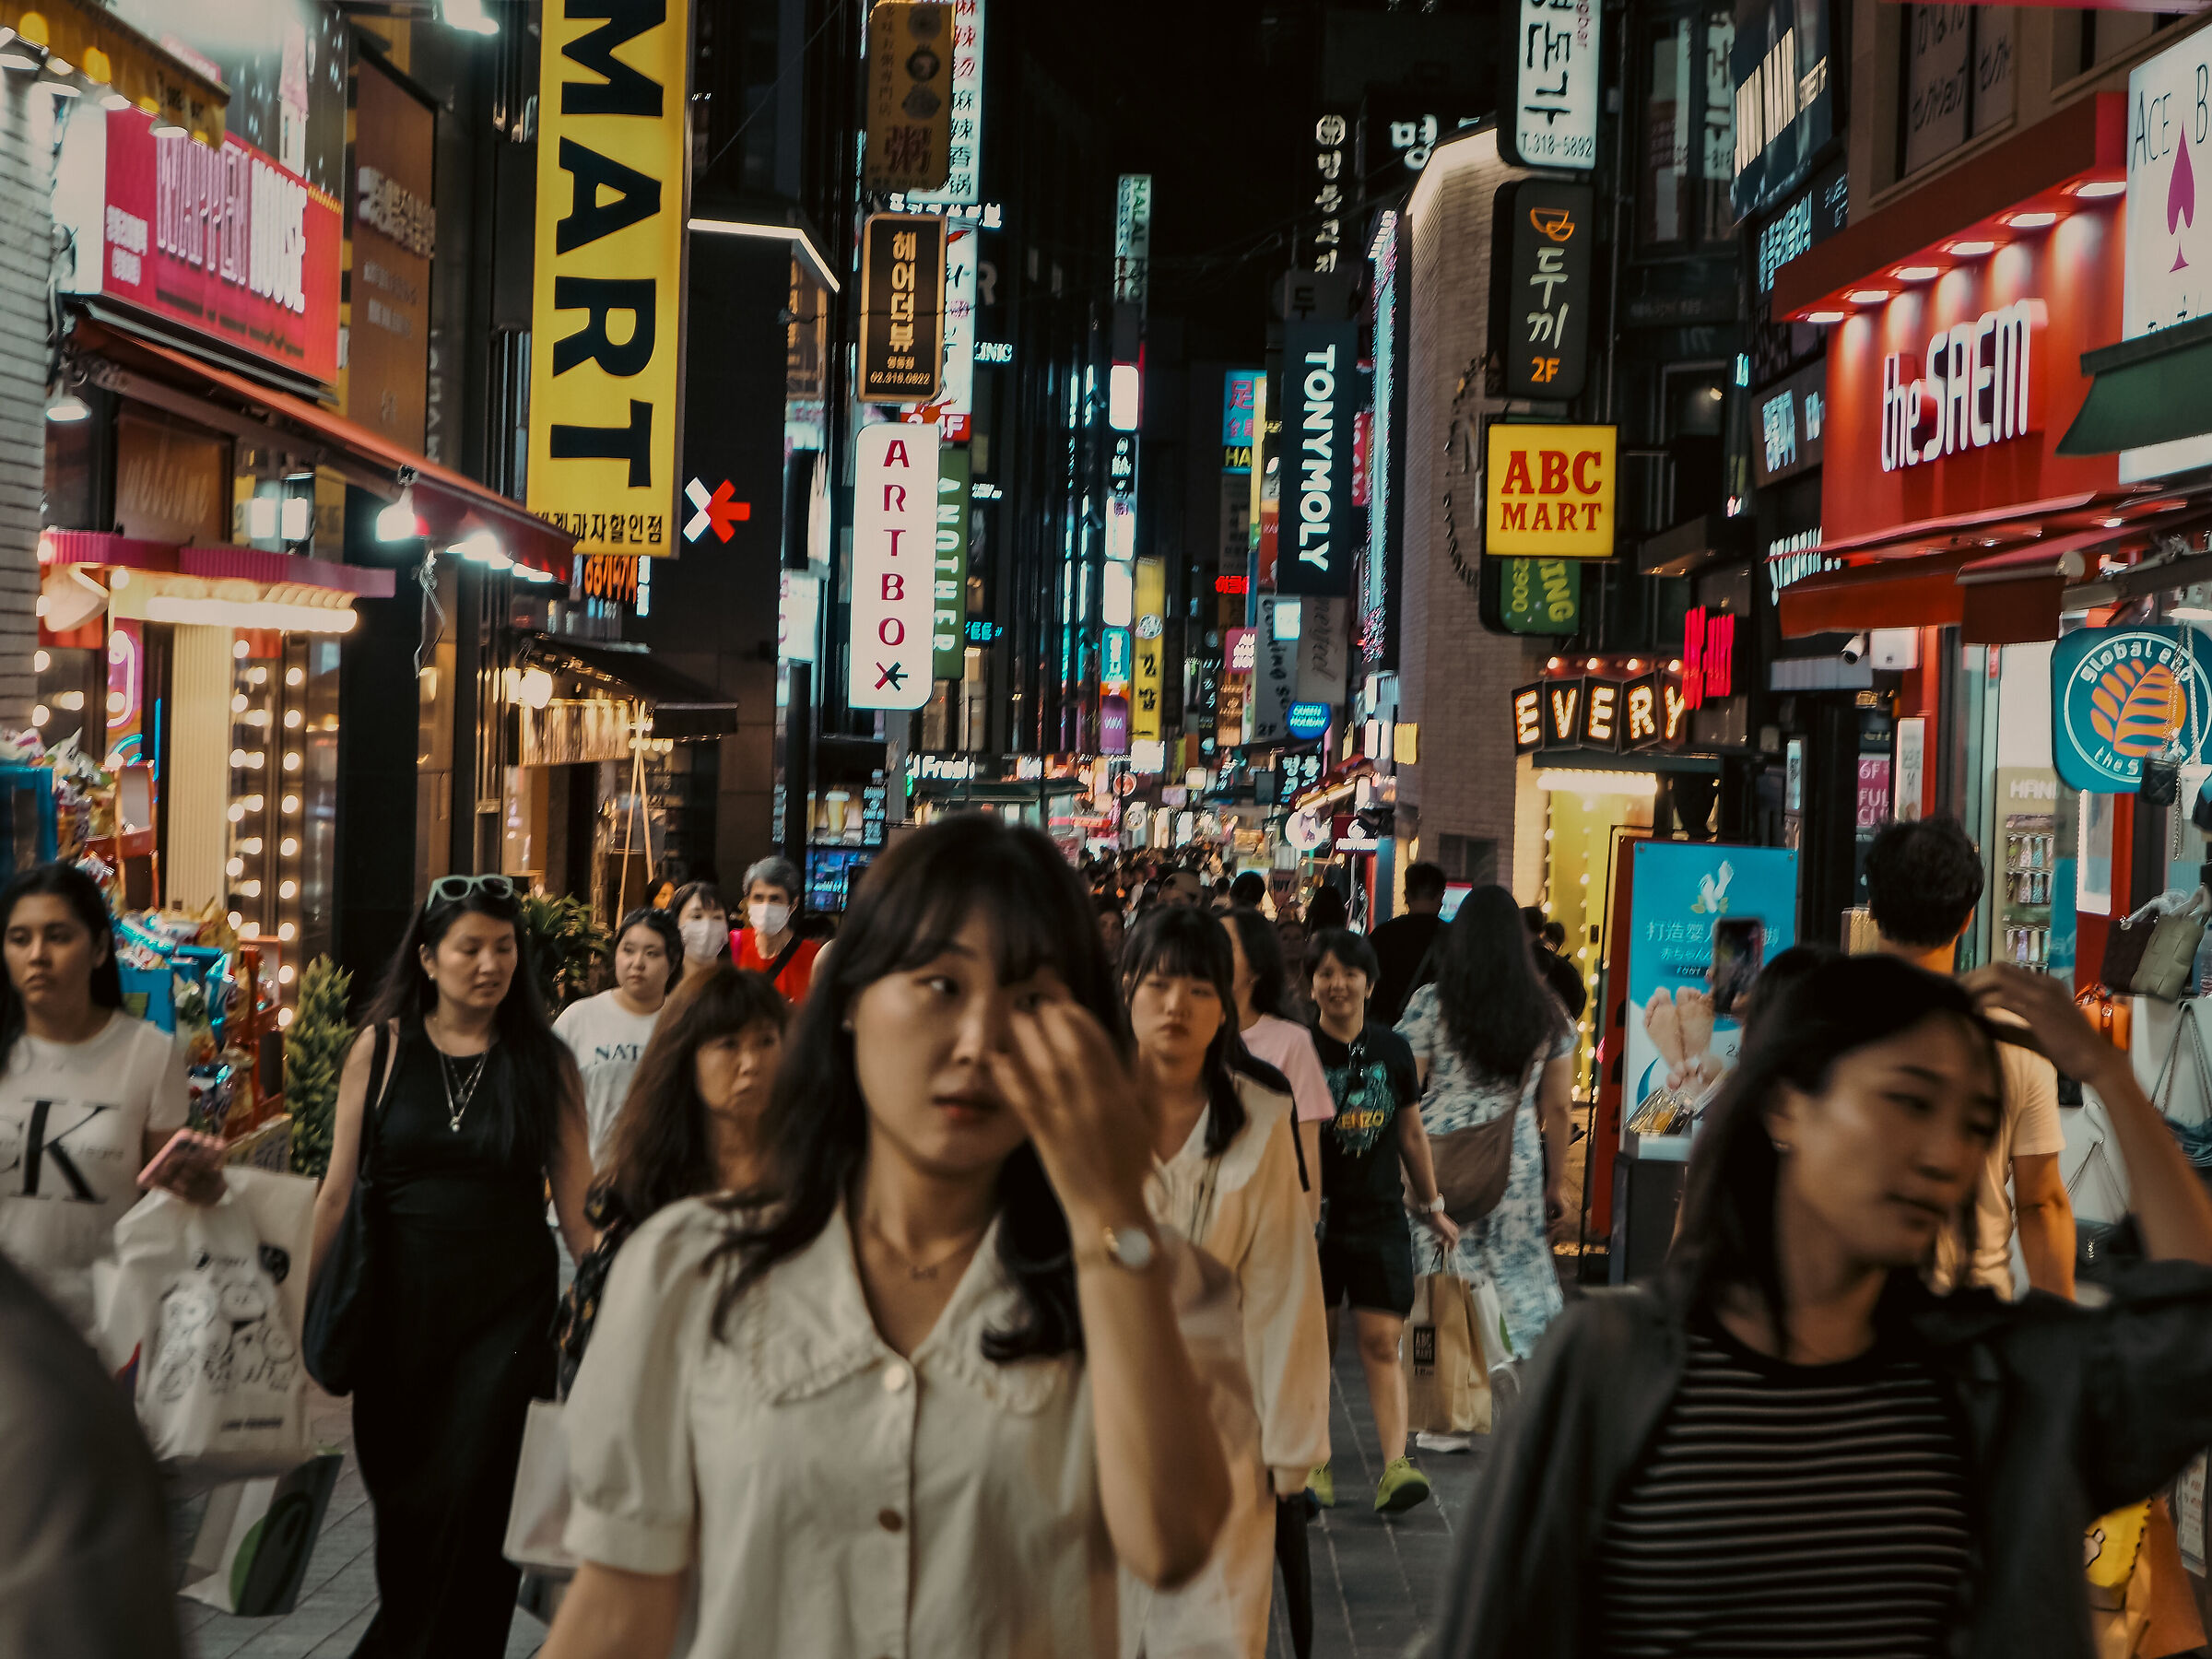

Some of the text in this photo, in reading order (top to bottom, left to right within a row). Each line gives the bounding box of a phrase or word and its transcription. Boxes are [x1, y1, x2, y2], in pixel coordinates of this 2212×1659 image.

[2131, 89, 2171, 174] ACE
[250, 158, 308, 314] HOUSE
[549, 0, 666, 488] MART
[888, 231, 916, 352] 헤어더뷰
[1526, 246, 1569, 350] 두끼
[973, 342, 1013, 362] LINIC
[1531, 357, 1559, 382] 2F
[1882, 352, 1922, 473] the
[1924, 301, 2031, 464] SAEM
[1299, 344, 1335, 572] TONYMOLY
[1500, 450, 1602, 495] ABC
[535, 511, 663, 544] 계과자할인점
[1500, 502, 1602, 531] MART
[933, 477, 961, 652] ANOTHER
[2079, 639, 2153, 684] global
[1516, 685, 1686, 745] EVERY
[1859, 760, 1880, 780] 6F
[2094, 746, 2124, 773] the
[594, 1042, 646, 1065] NAT
